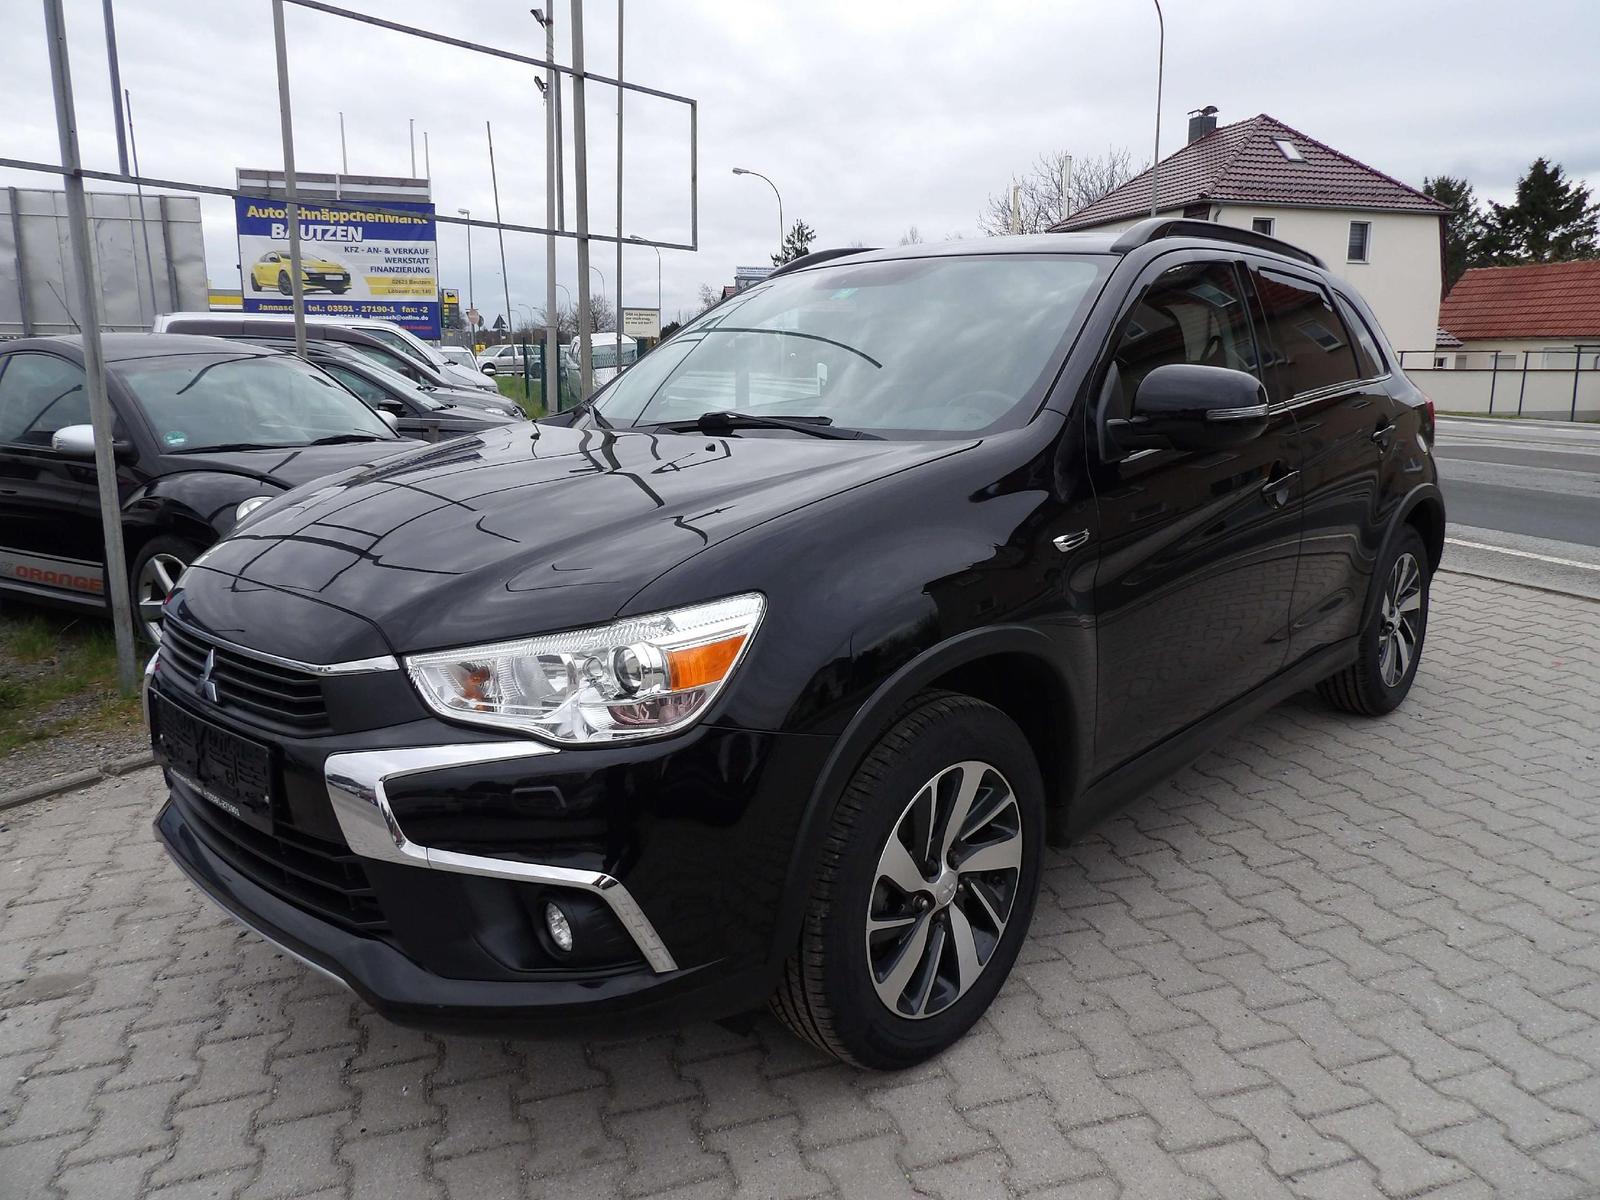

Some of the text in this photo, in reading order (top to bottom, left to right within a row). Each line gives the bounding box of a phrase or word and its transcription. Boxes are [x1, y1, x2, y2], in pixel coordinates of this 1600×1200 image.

[247, 205, 428, 224] AutohnäppchenMar
[344, 246, 360, 254] KFZ
[392, 248, 430, 256] VERKAUF
[384, 257, 430, 265] WERKSTATT
[370, 266, 430, 274] FINANZIERUNG
[327, 305, 354, 313] 03591
[361, 305, 396, 313] 27190-1
[419, 306, 429, 314] -2
[15, 565, 104, 592] ORANGE
